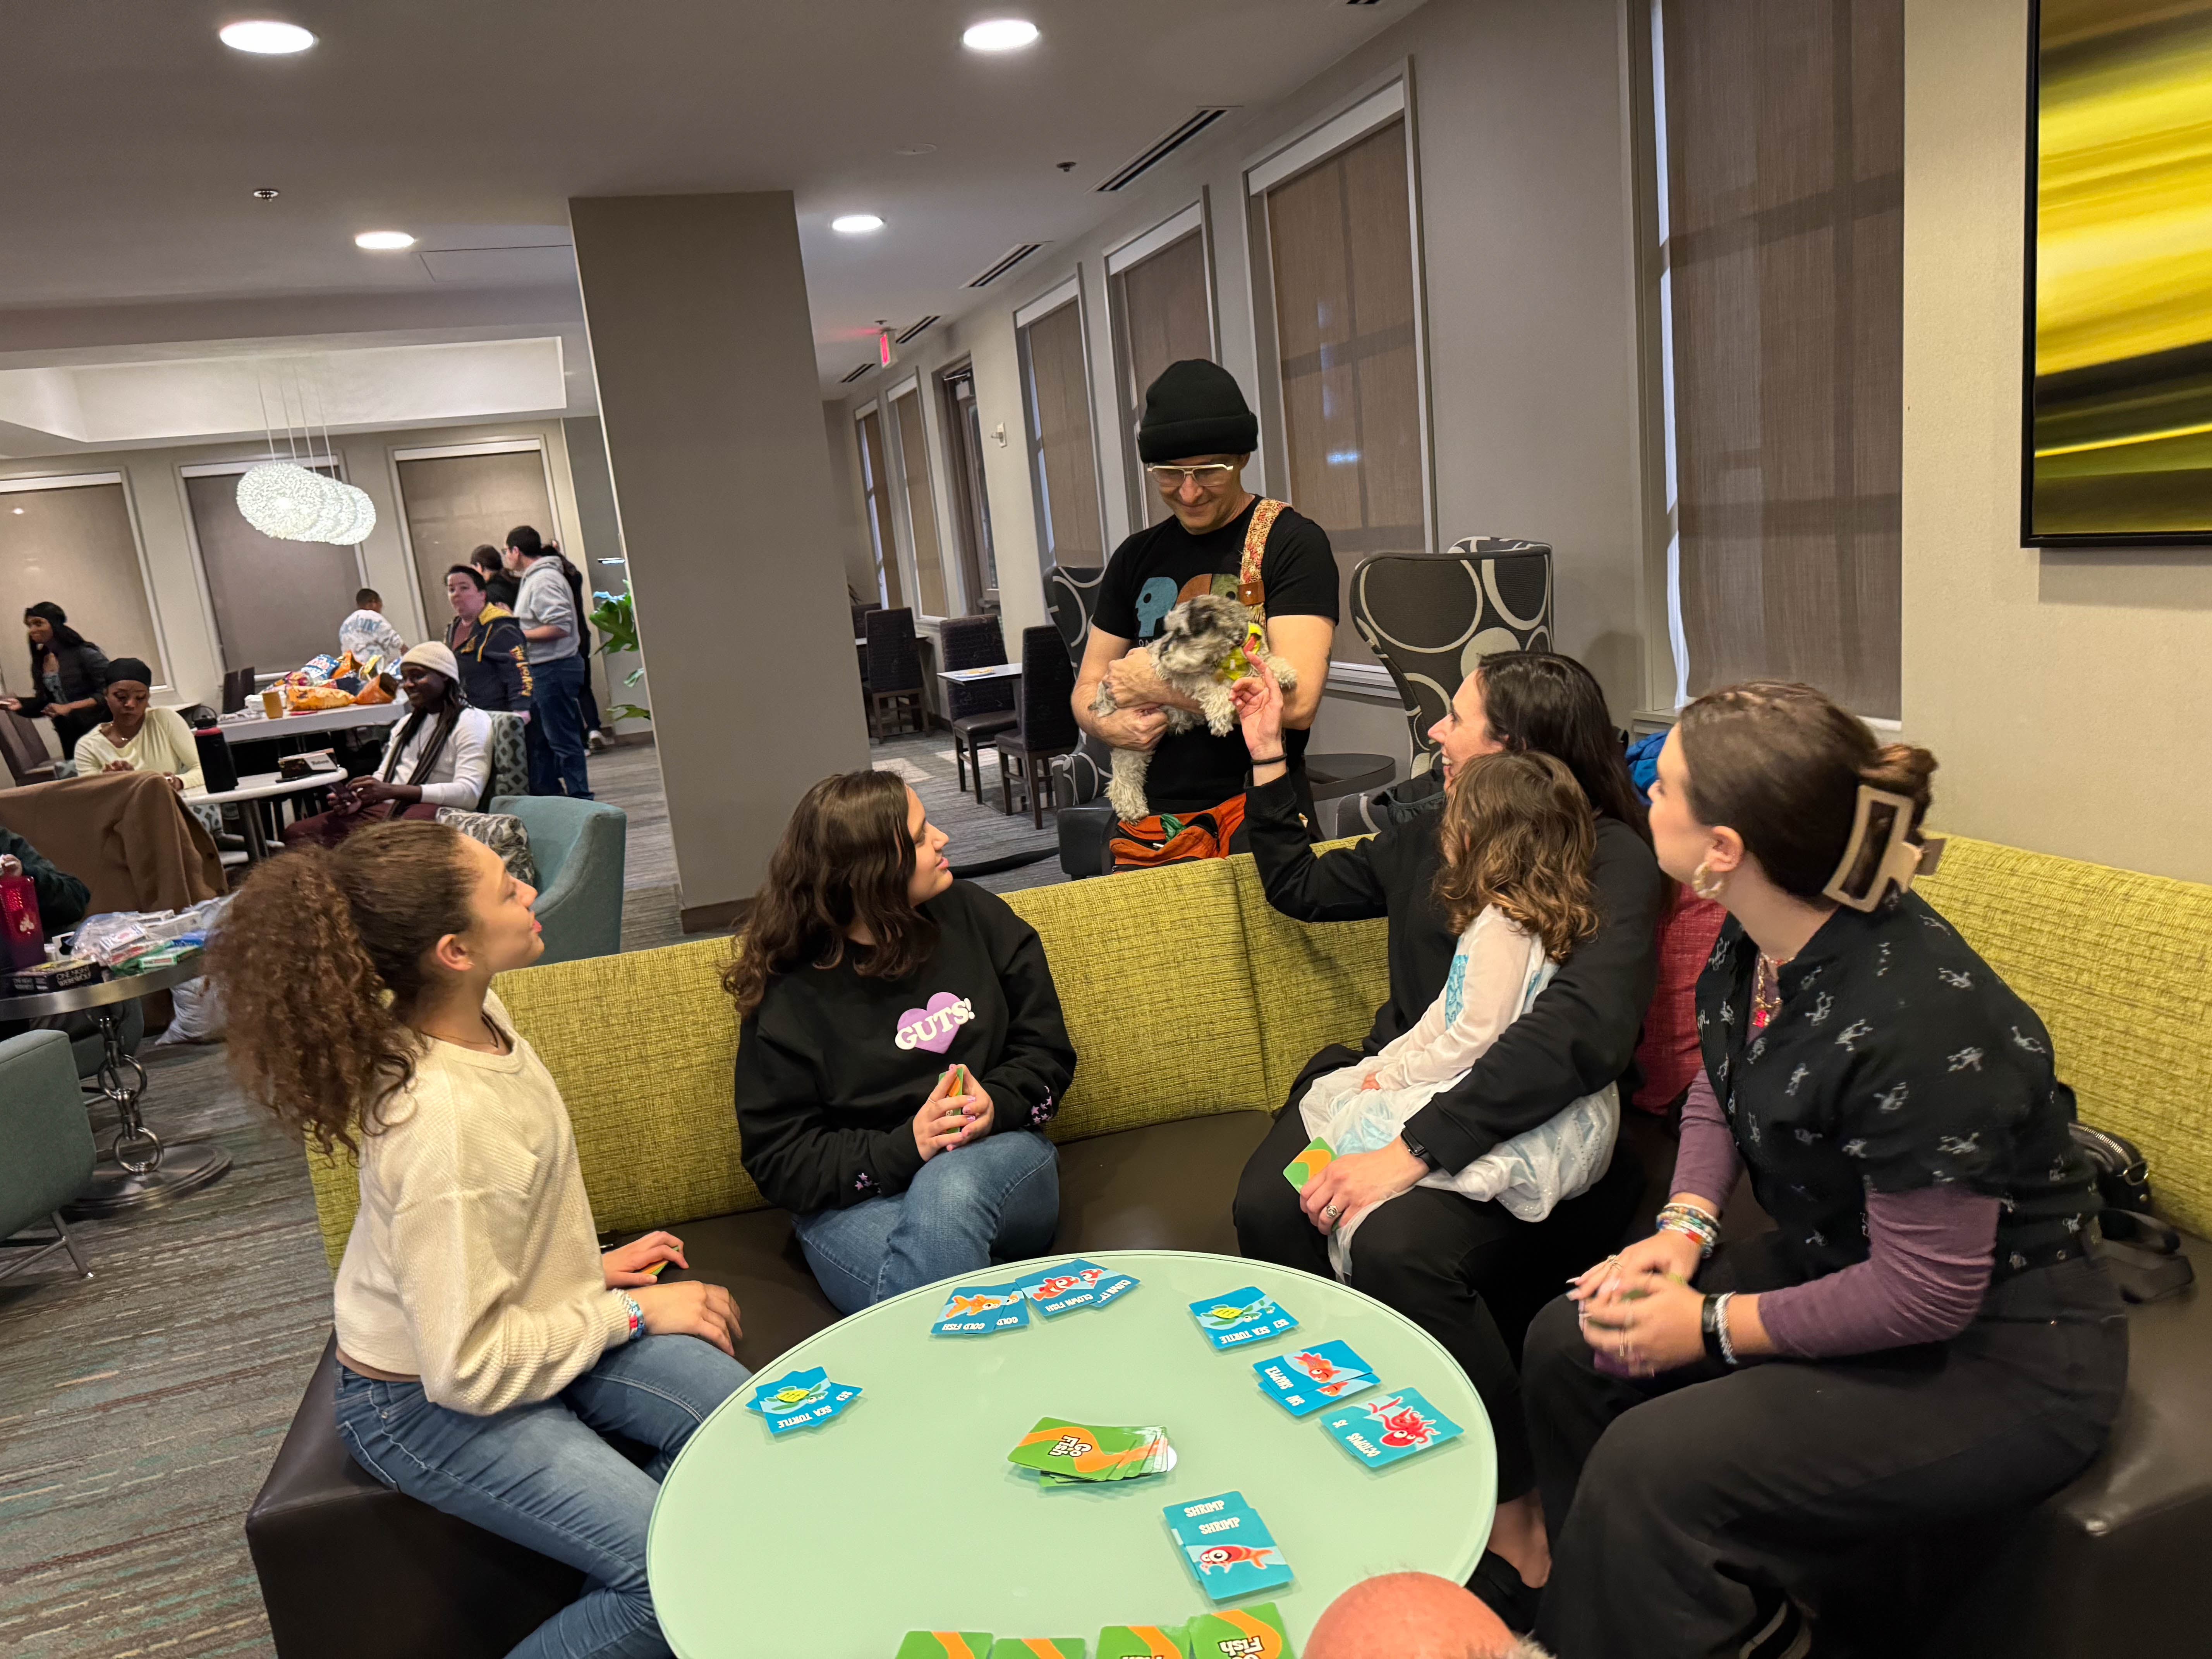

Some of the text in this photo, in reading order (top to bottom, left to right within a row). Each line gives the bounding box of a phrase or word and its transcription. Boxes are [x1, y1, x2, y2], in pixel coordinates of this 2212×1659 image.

[895, 998, 975, 1050] GUTS!
[1106, 1279, 1131, 1294] CLOWN
[1045, 1293, 1094, 1312] CLOWN FISH
[996, 1316, 1018, 1326] GOLD
[1219, 1326, 1271, 1344] SEA TURTLE
[1264, 1365, 1294, 1389] SNAPPER
[777, 1405, 832, 1428] SEA TURTLE
[1048, 1435, 1080, 1456] Fish
[1069, 1443, 1092, 1457] Go
[1345, 1432, 1381, 1457] OCTOPUS
[1184, 1500, 1224, 1517] SHRIMP
[1199, 1517, 1240, 1534] SHRIMP
[1218, 1636, 1265, 1657] Fish
